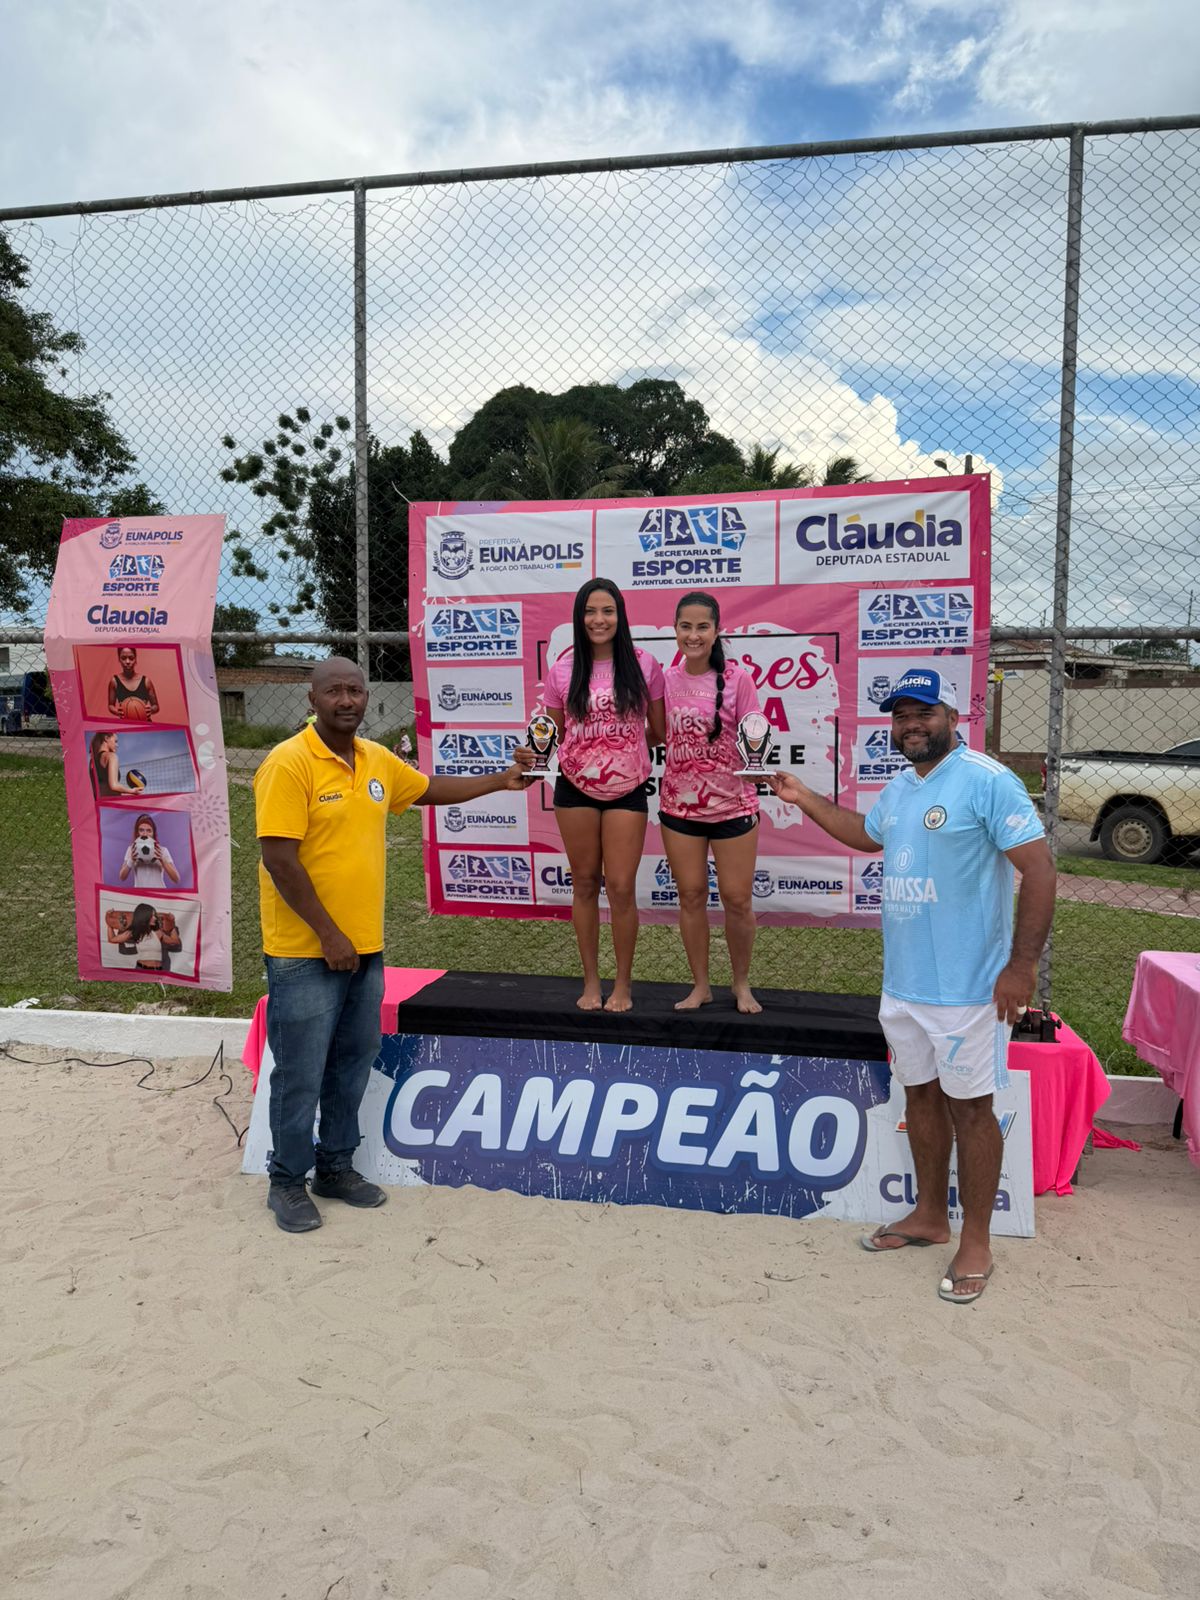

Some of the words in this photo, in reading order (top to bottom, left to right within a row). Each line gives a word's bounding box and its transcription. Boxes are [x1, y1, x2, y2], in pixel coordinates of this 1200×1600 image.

[479, 543, 584, 563] EUNÁPOLIS
[654, 549, 708, 557] SECRETARIA
[816, 554, 882, 566] DEPUTADA
[885, 552, 950, 564] ESTADUAL
[632, 558, 742, 577] ESPORTE
[102, 582, 160, 592] ESPORTE
[883, 620, 936, 628] SECRETARIA
[861, 626, 969, 640] ESPORTE
[427, 640, 517, 652] ESPORTE
[461, 691, 513, 701] EUNÁPOLIS
[590, 712, 611, 721] DAS
[677, 735, 695, 744] DAS
[435, 765, 510, 775] ESPORT
[467, 814, 517, 824] EUNÁPOLIS
[445, 883, 530, 896] ESPORTE
[778, 879, 843, 890] EUNÁPOLIS
[885, 877, 939, 903] EVASSA
[946, 1035, 966, 1063] 7
[391, 1070, 860, 1177] CAMPEÃO
